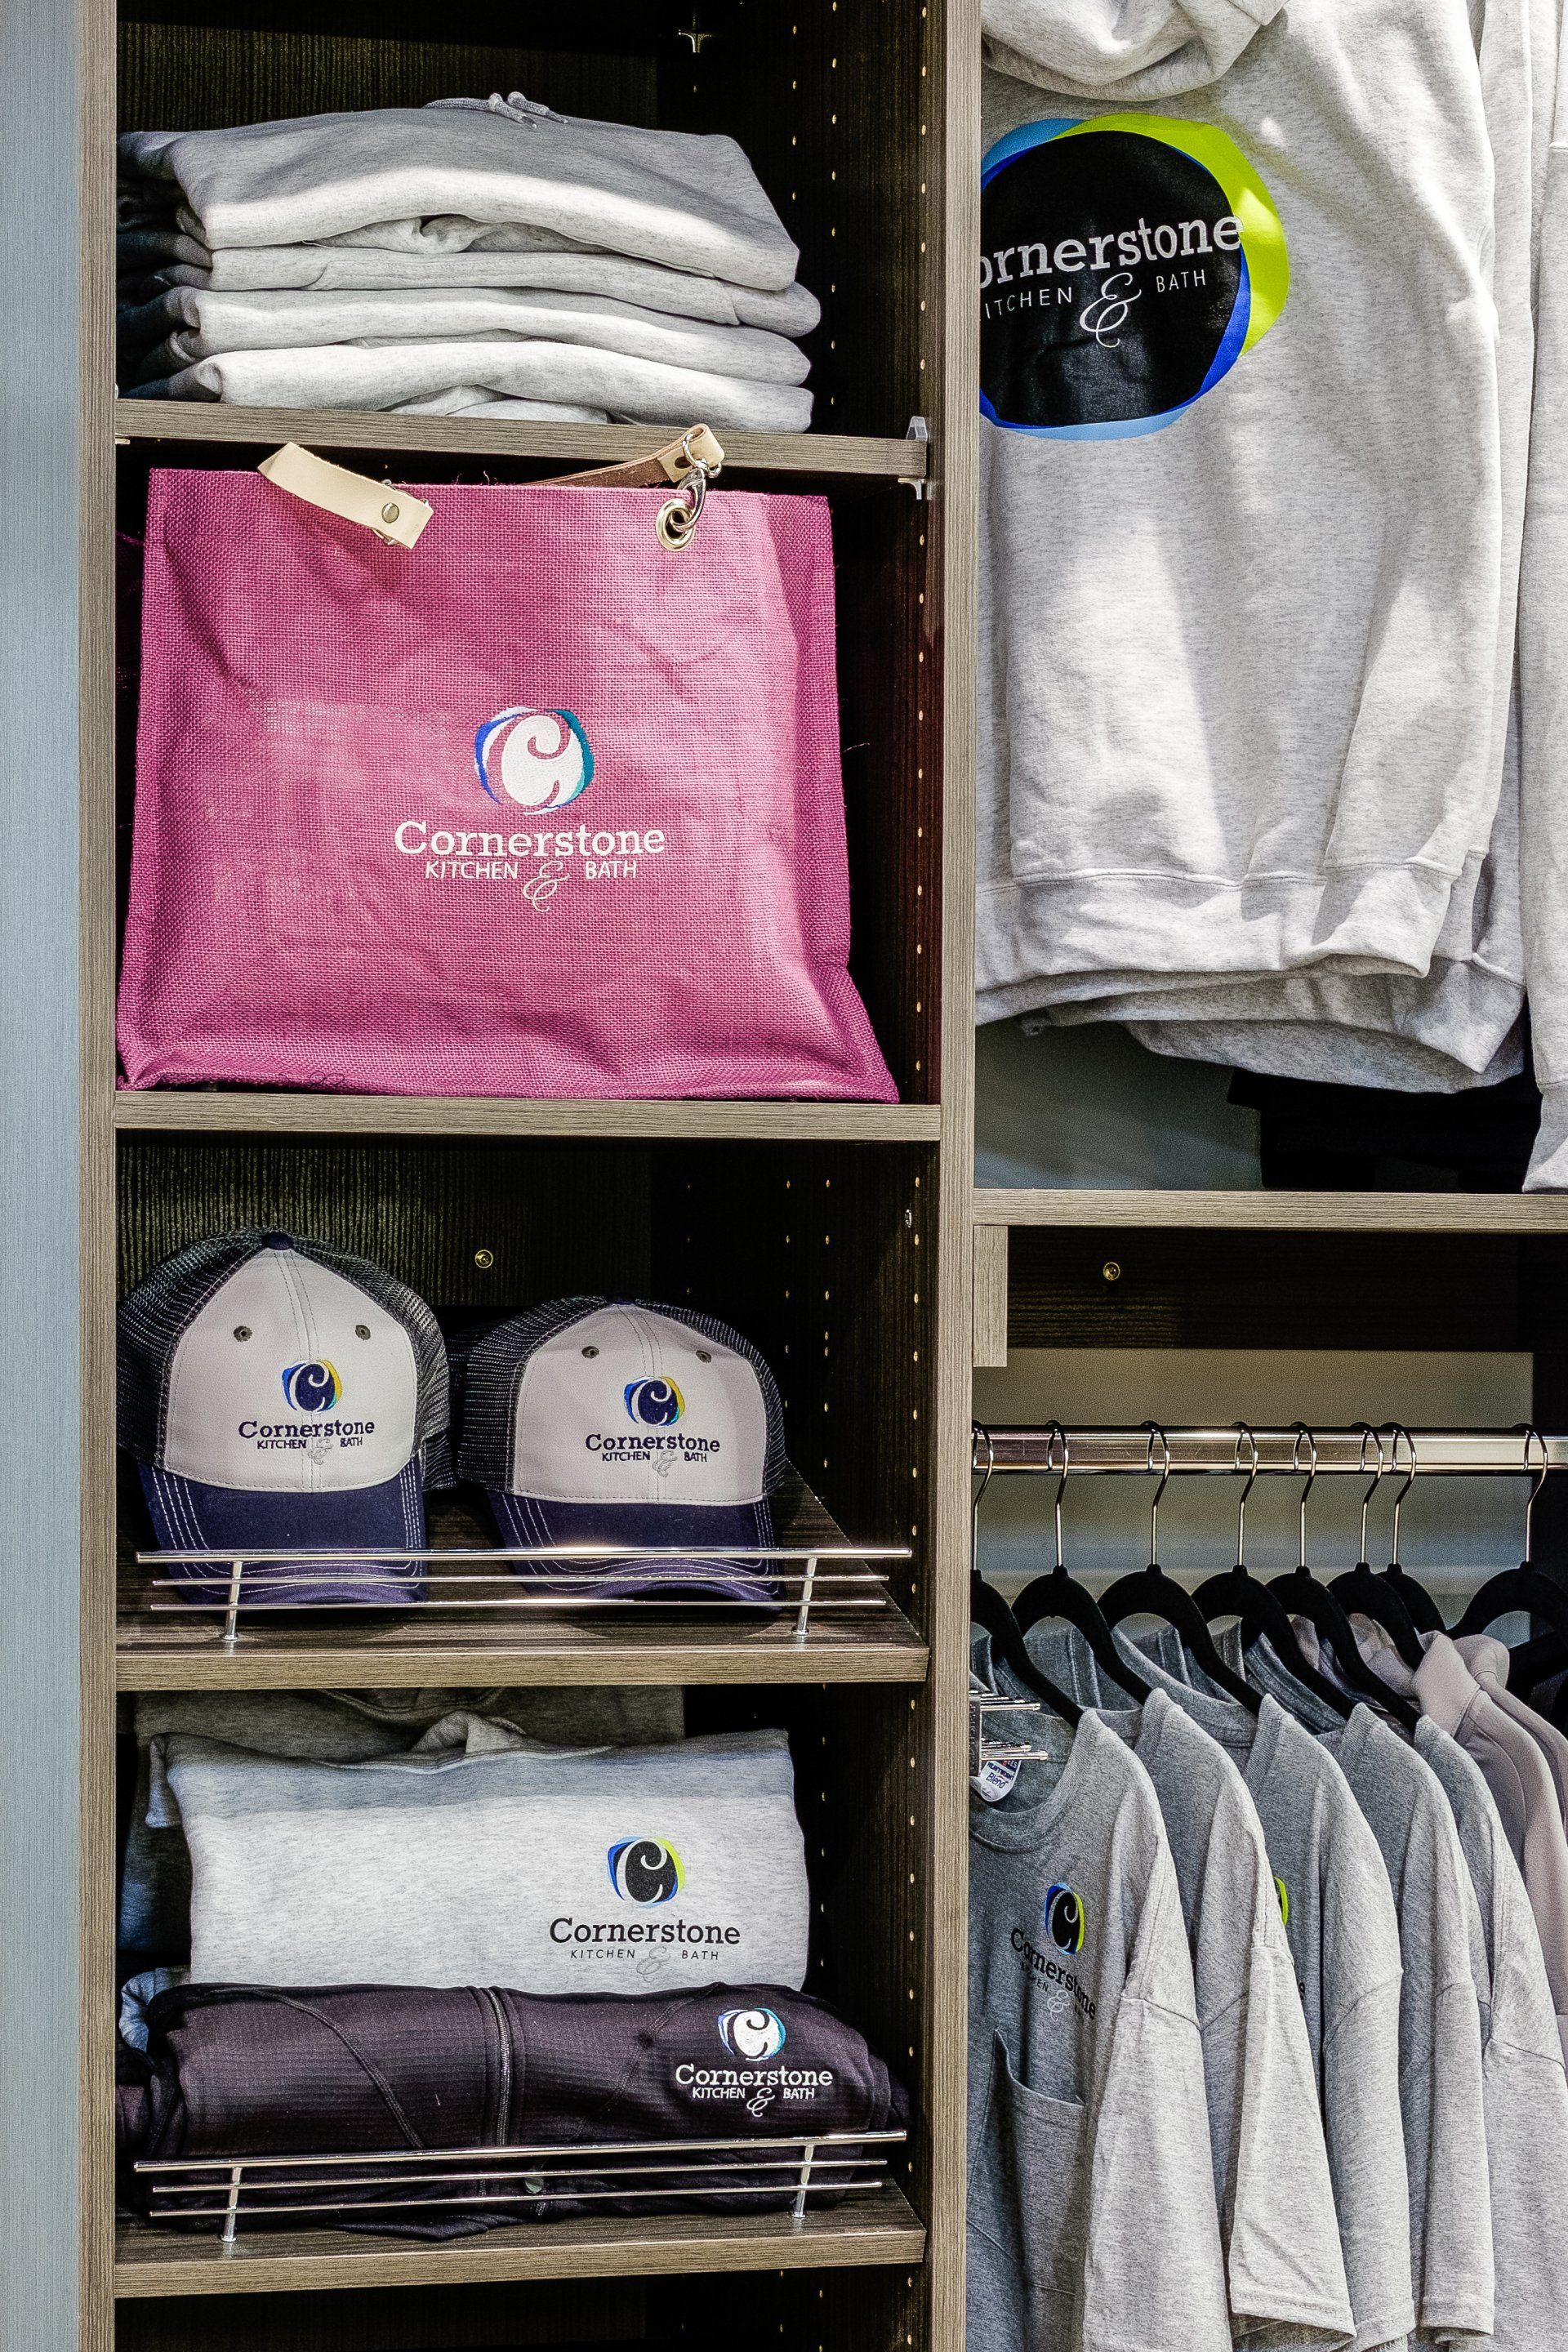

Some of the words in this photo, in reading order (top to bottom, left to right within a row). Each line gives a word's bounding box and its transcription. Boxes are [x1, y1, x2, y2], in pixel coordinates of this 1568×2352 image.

[979, 215, 1244, 289] ornerstone
[984, 286, 1072, 319] ITCHEN
[1079, 272, 1143, 348] &
[1156, 269, 1207, 293] BATH
[394, 821, 666, 858] Cornerstone
[425, 860, 519, 880] KITCHEN
[522, 860, 571, 913] &
[585, 860, 637, 880] BATH
[238, 1419, 376, 1439] Cornerstone
[256, 1439, 307, 1450] KITCHEN
[340, 1437, 363, 1448] BATH
[585, 1432, 720, 1453] Cornerstone
[602, 1451, 651, 1462] KITCHEN
[684, 1451, 708, 1463] BATH
[549, 1918, 741, 1945] Cornerstone
[570, 1949, 636, 1959] KITCHEN
[636, 1946, 671, 1983] &
[681, 1949, 719, 1961] BATH
[1011, 1928, 1096, 2020] Cornerstone
[675, 2063, 834, 2087] Cornerstone
[693, 2087, 746, 2100] KITCHEN
[746, 2087, 776, 2118] &
[782, 2087, 815, 2100] BATH
